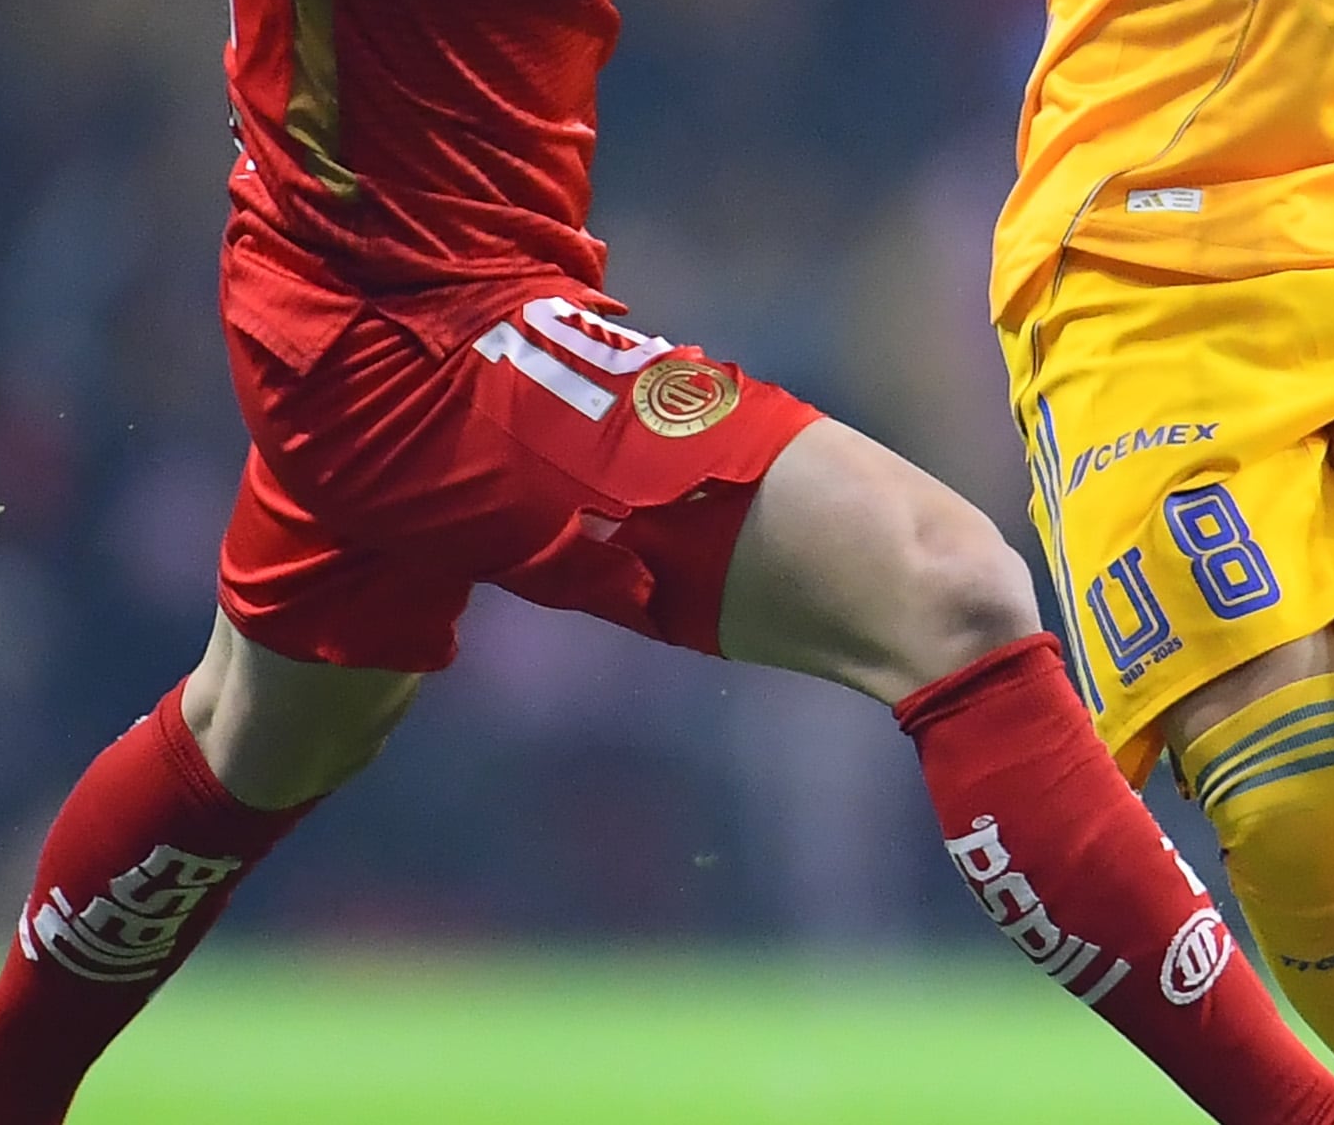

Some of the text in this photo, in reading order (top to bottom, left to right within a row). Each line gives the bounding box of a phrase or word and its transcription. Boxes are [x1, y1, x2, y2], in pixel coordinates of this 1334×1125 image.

[472, 296, 674, 421] 10
[1094, 423, 1219, 471] CEMEX
[1163, 482, 1281, 620] 8
